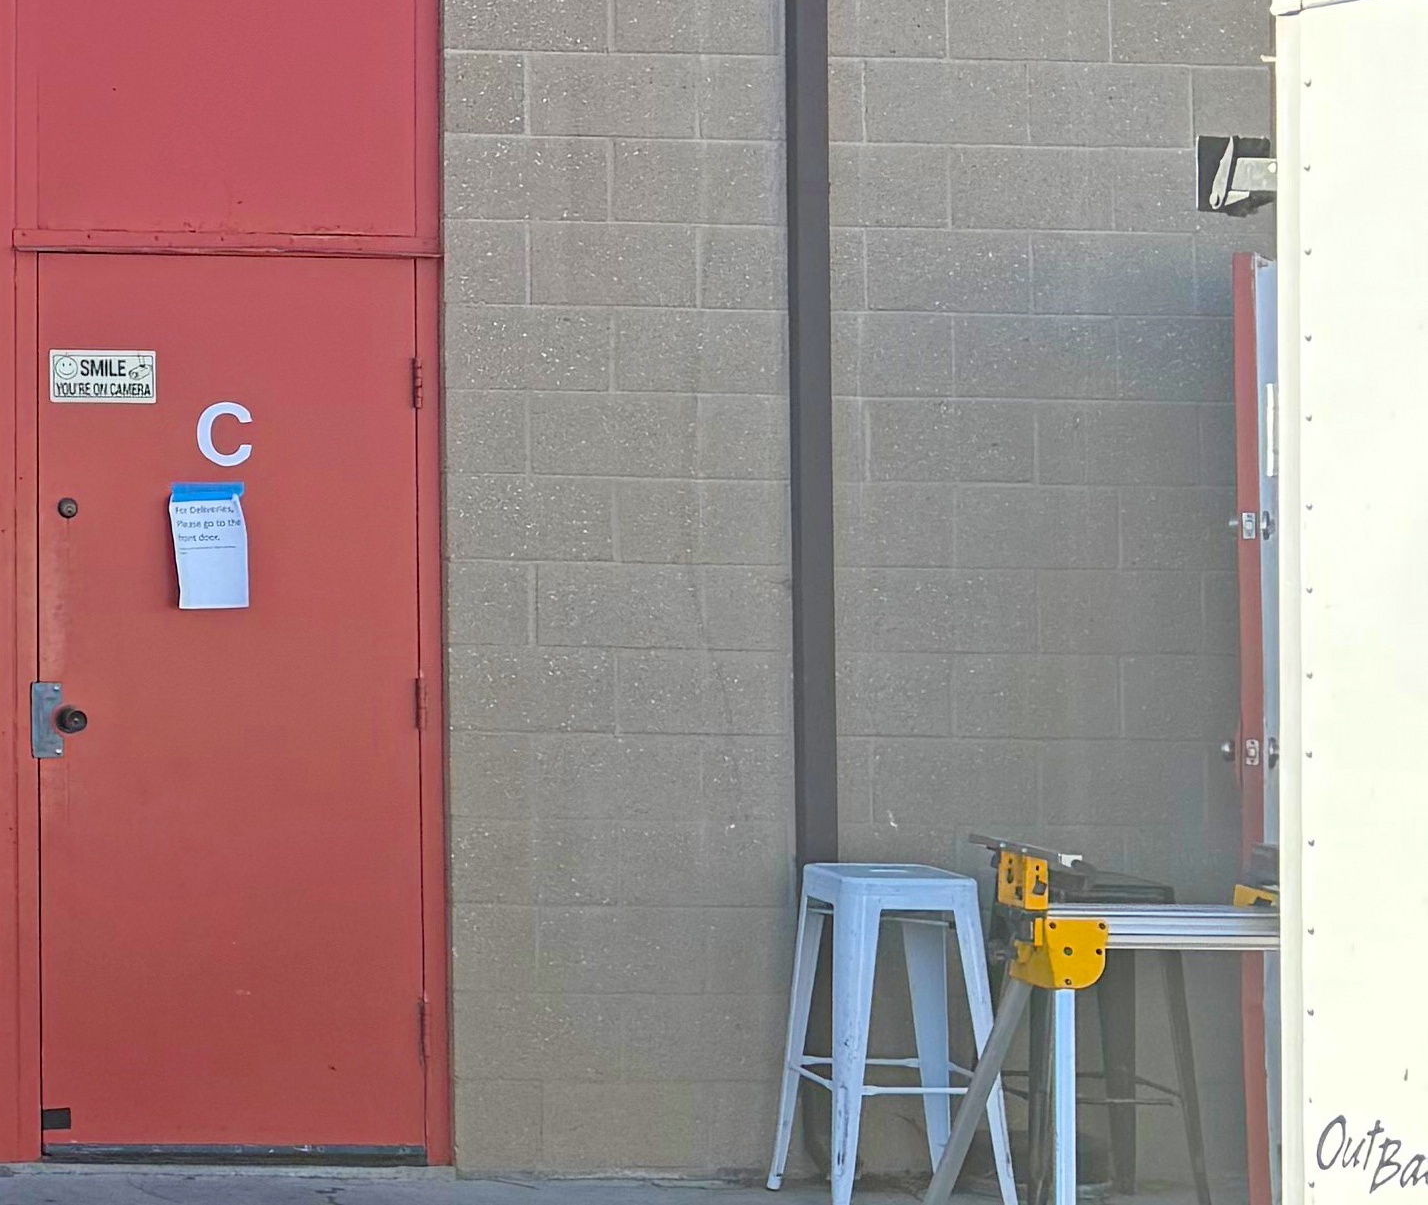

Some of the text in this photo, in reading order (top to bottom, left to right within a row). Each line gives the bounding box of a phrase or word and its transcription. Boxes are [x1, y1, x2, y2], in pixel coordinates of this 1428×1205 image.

[80, 359, 126, 377] SMILE
[56, 382, 151, 396] YOU'RE ON CAMERA
[197, 401, 253, 467] C
[175, 506, 187, 514] For
[177, 520, 201, 528] Please
[203, 520, 214, 529] go
[227, 518, 241, 527] the
[178, 534, 197, 542] front
